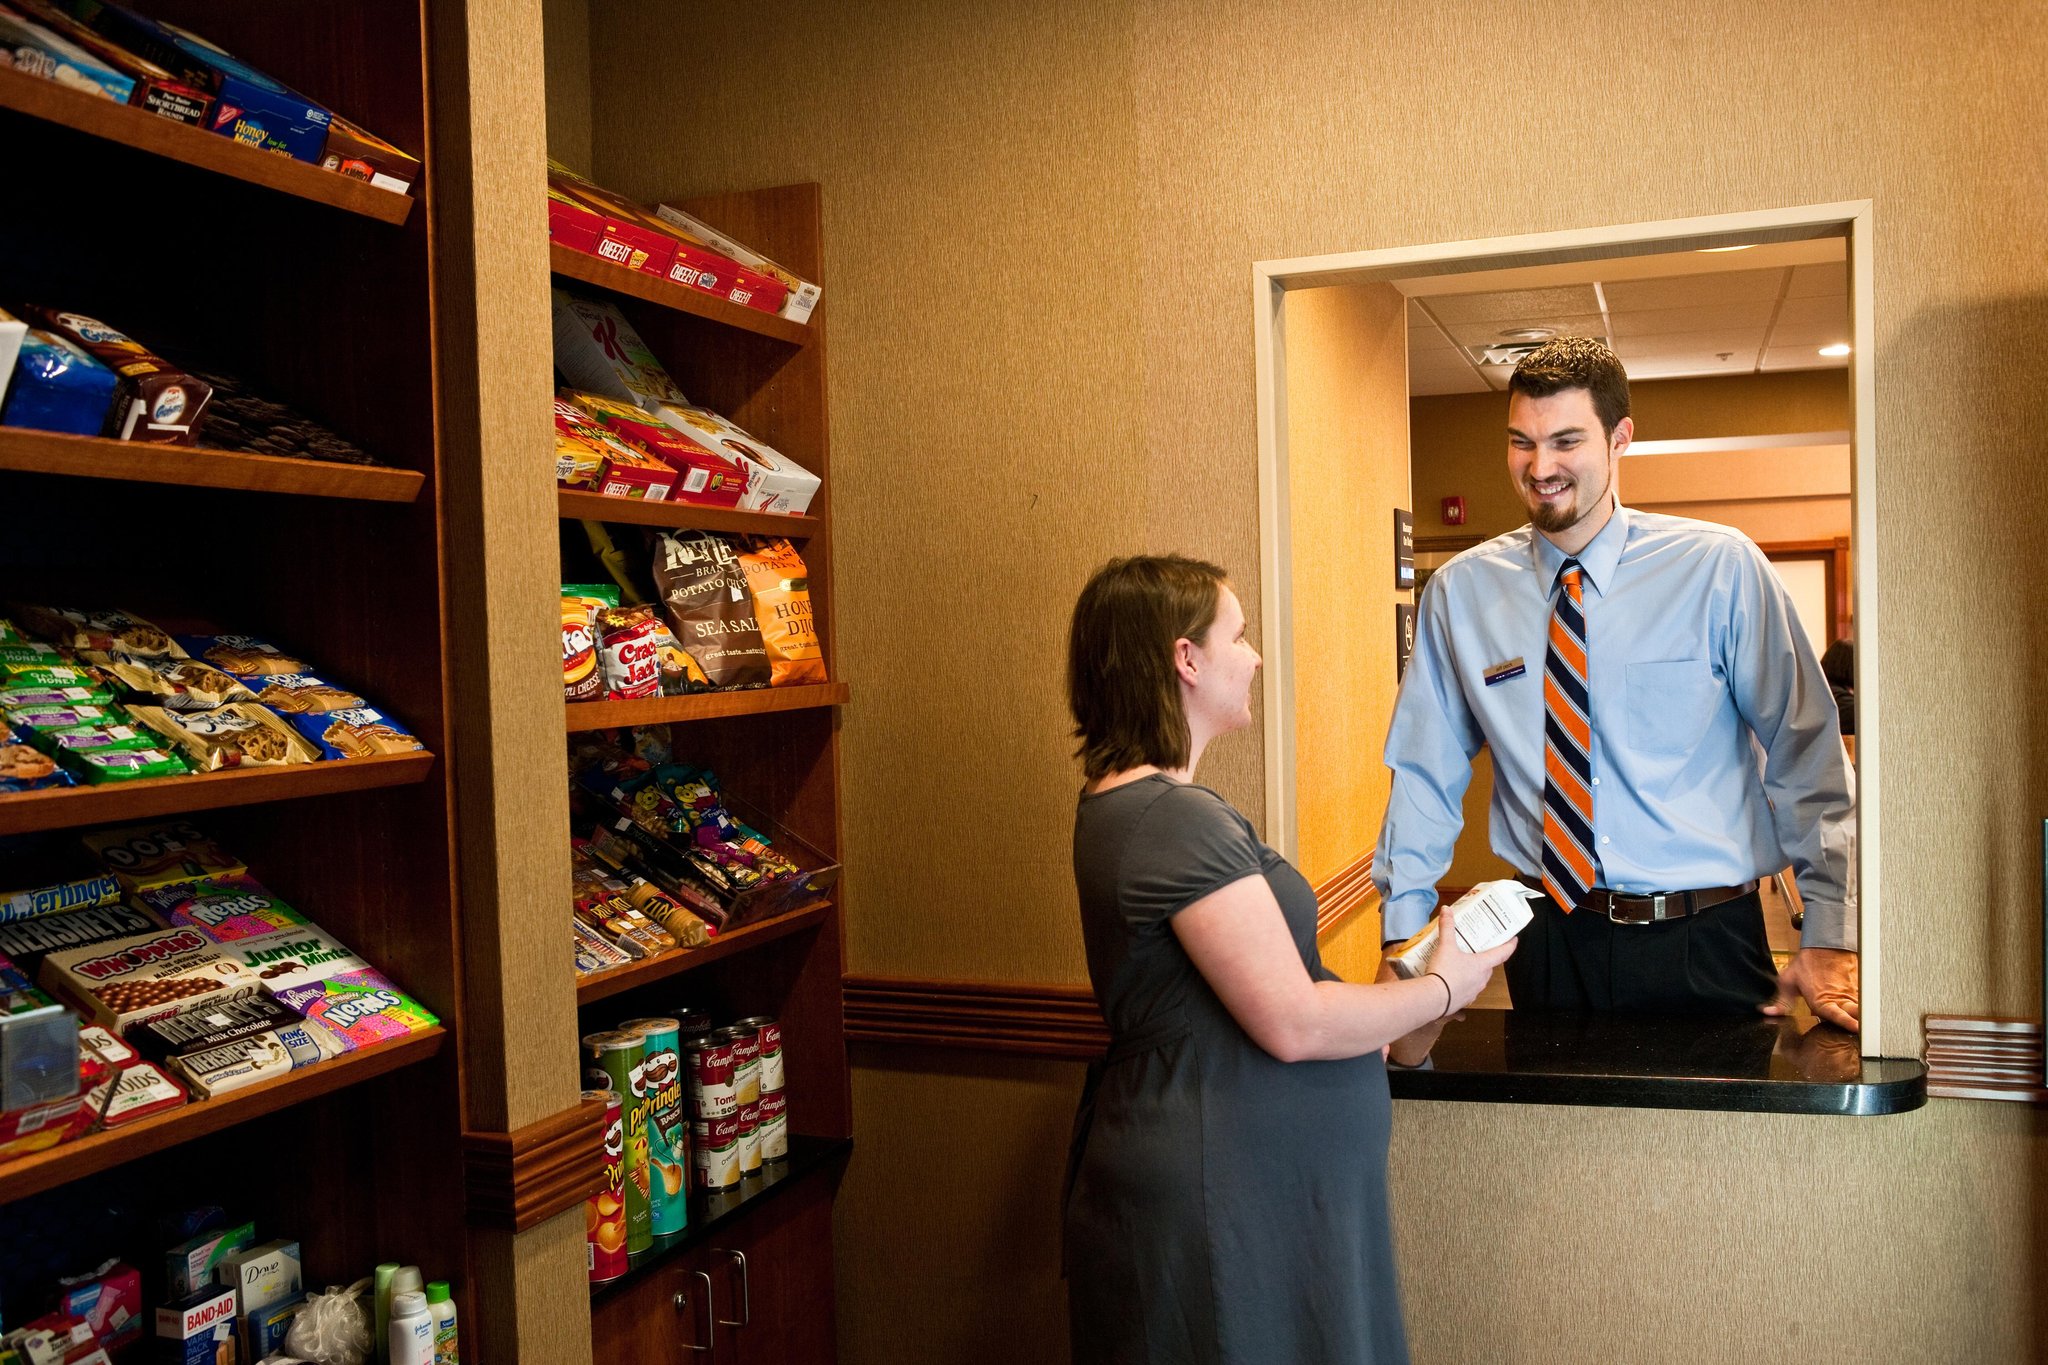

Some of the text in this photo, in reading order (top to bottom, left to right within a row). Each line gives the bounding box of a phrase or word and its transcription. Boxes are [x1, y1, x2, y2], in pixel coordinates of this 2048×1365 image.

[234, 118, 269, 140] Honey
[233, 132, 261, 149] Maid
[598, 238, 632, 263] CHEEZ-IT
[669, 263, 700, 285] CHEEZ-IT
[695, 564, 724, 577] BRAN
[670, 577, 748, 601] POTATO CHIP
[774, 600, 813, 620] HONE
[695, 620, 730, 638] SEA
[618, 641, 657, 665] Crac
[705, 650, 726, 660] great
[37, 676, 77, 685] HONEY
[105, 822, 202, 867] DOTS
[79, 932, 202, 978] WHOPPERS
[244, 937, 321, 967] Junior
[299, 948, 352, 967] Mints
[153, 967, 181, 979] MALTED
[181, 961, 200, 973] MILK
[279, 987, 321, 1009] Wonka
[204, 1018, 272, 1044] Milk Chocolate
[279, 1028, 305, 1042] KING
[288, 1036, 310, 1049] SIZE
[184, 1041, 258, 1075] HERSHEY'S
[646, 1081, 682, 1116] Pringle
[660, 1106, 681, 1127] RANCH
[245, 1261, 279, 1285] Dove
[187, 1297, 234, 1331] BAND-AID
[186, 1328, 215, 1348] VARIE
